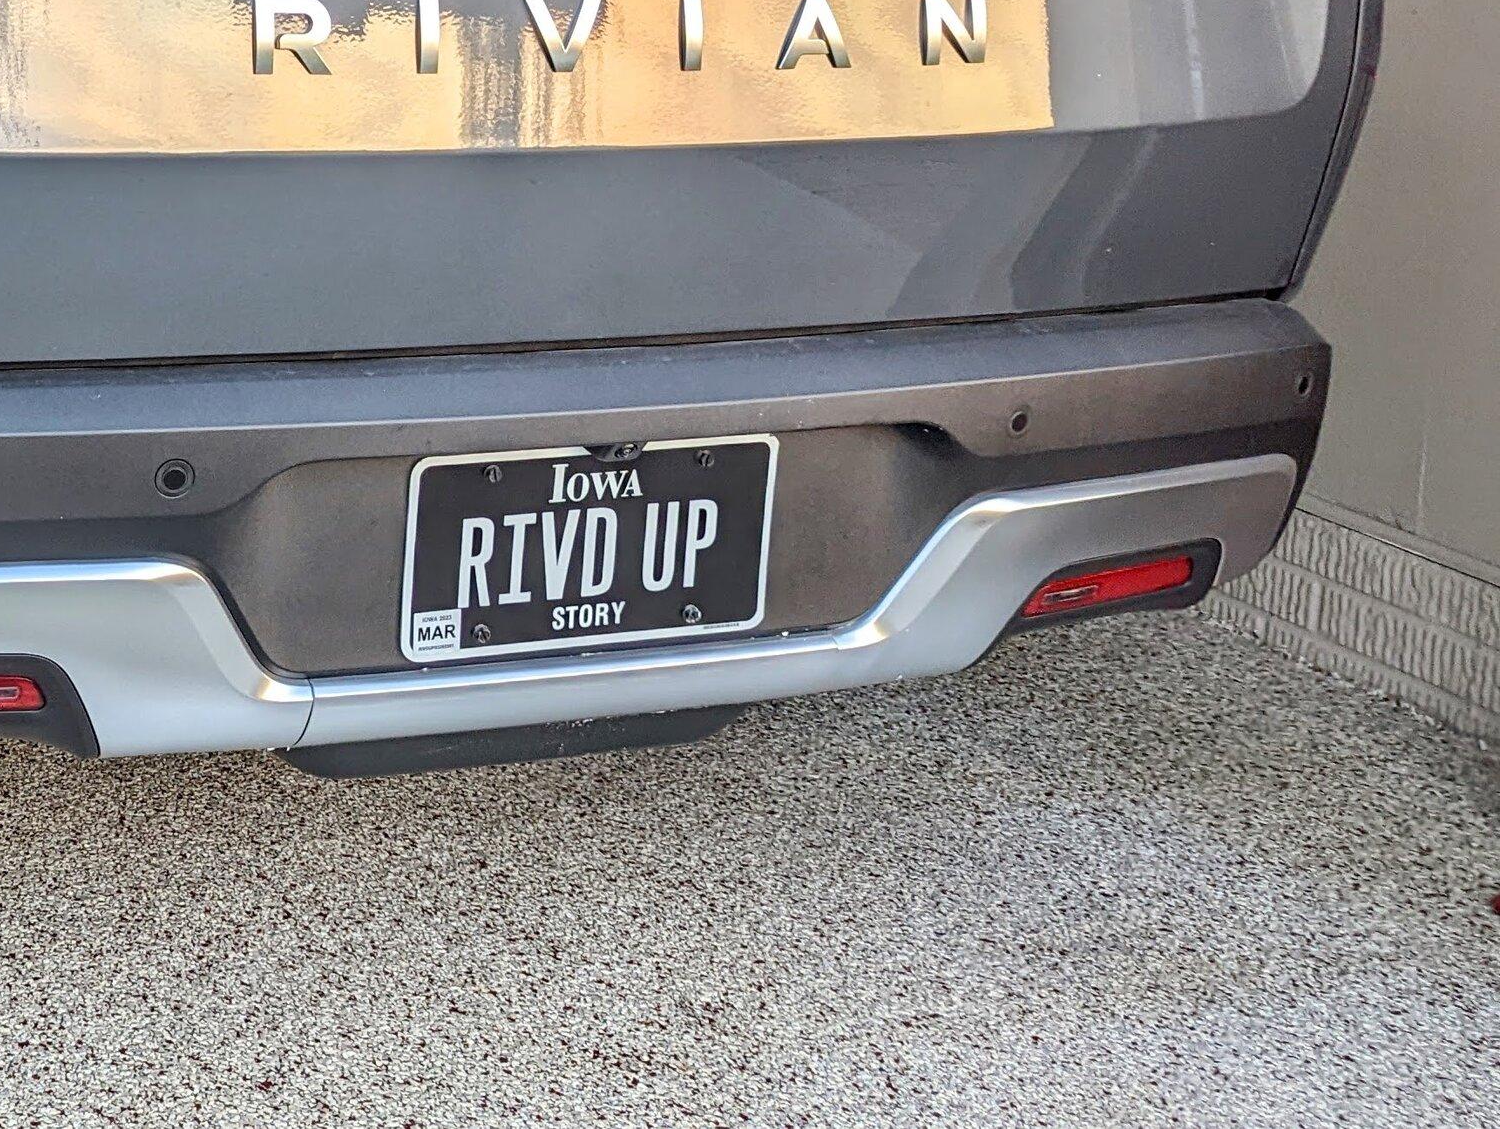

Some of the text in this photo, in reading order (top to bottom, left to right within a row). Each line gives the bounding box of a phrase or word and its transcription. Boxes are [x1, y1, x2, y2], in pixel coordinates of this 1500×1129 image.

[548, 463, 644, 505] IOWA
[457, 498, 719, 609] RIVD UP
[417, 624, 457, 642] MAR
[551, 600, 627, 632] STORY
